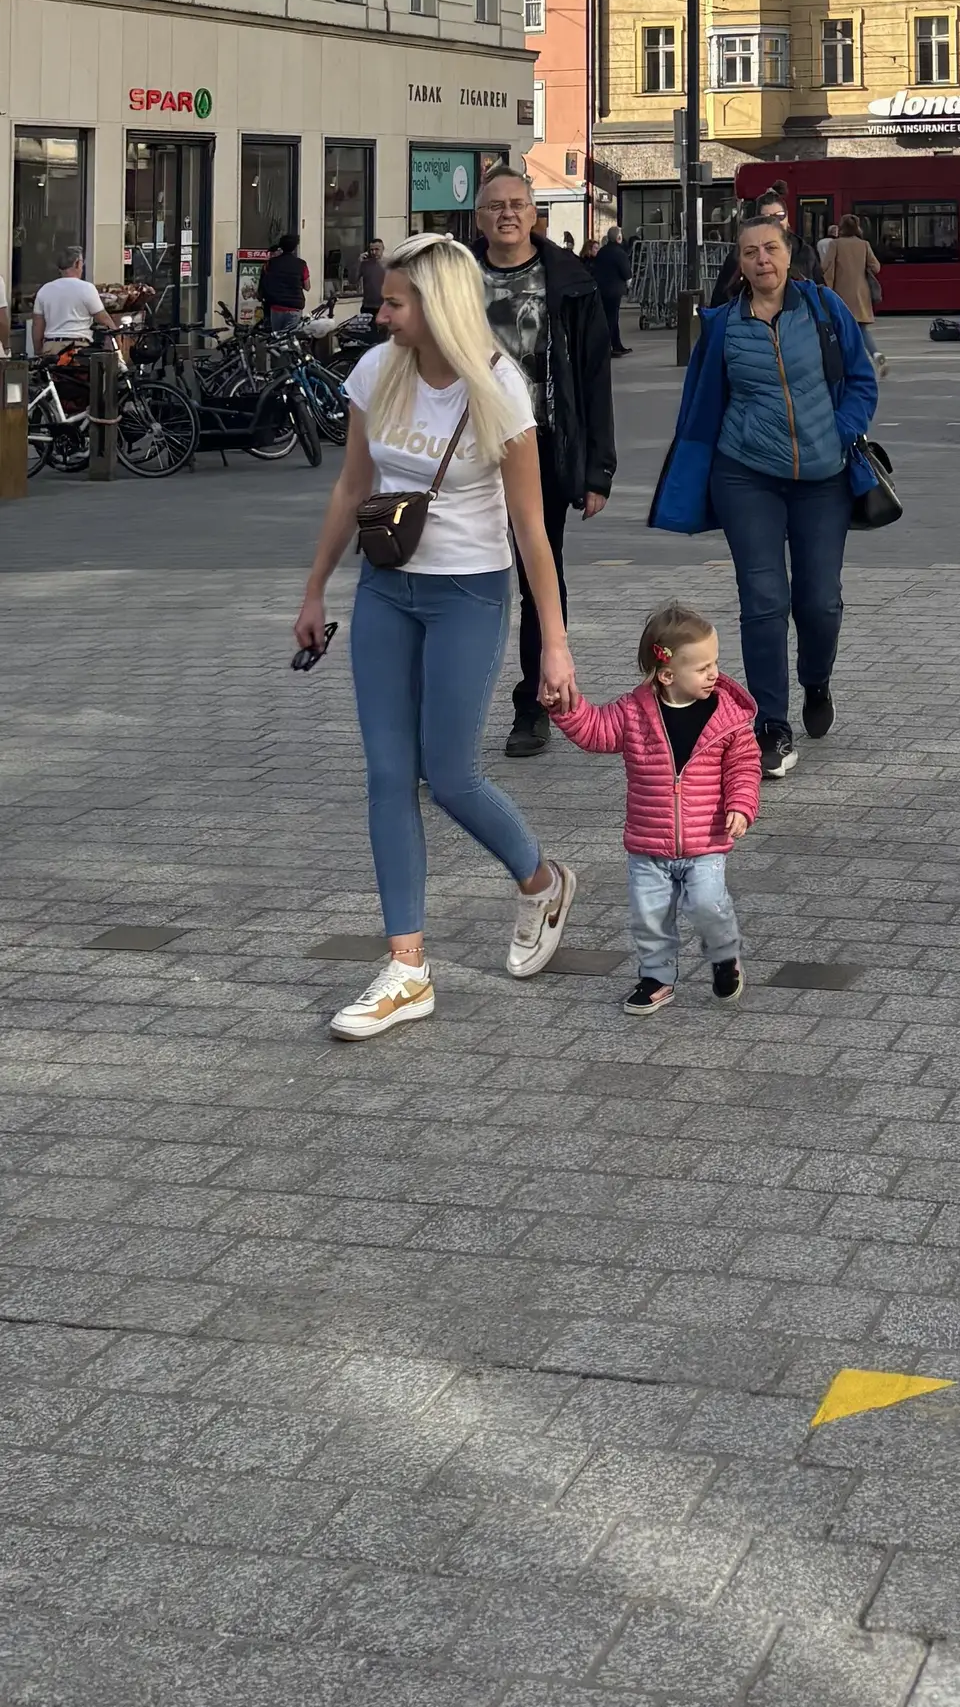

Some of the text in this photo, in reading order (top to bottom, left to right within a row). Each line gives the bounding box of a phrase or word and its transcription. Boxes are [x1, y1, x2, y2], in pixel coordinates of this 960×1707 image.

[129, 88, 193, 113] SPAR
[408, 83, 508, 108] TABAK ZIGARREN
[868, 125, 901, 135] VIENNA
[902, 124, 956, 134] INSURANCE
[424, 158, 450, 176] original
[412, 176, 431, 191] resh.
[241, 266, 261, 275] AKT
